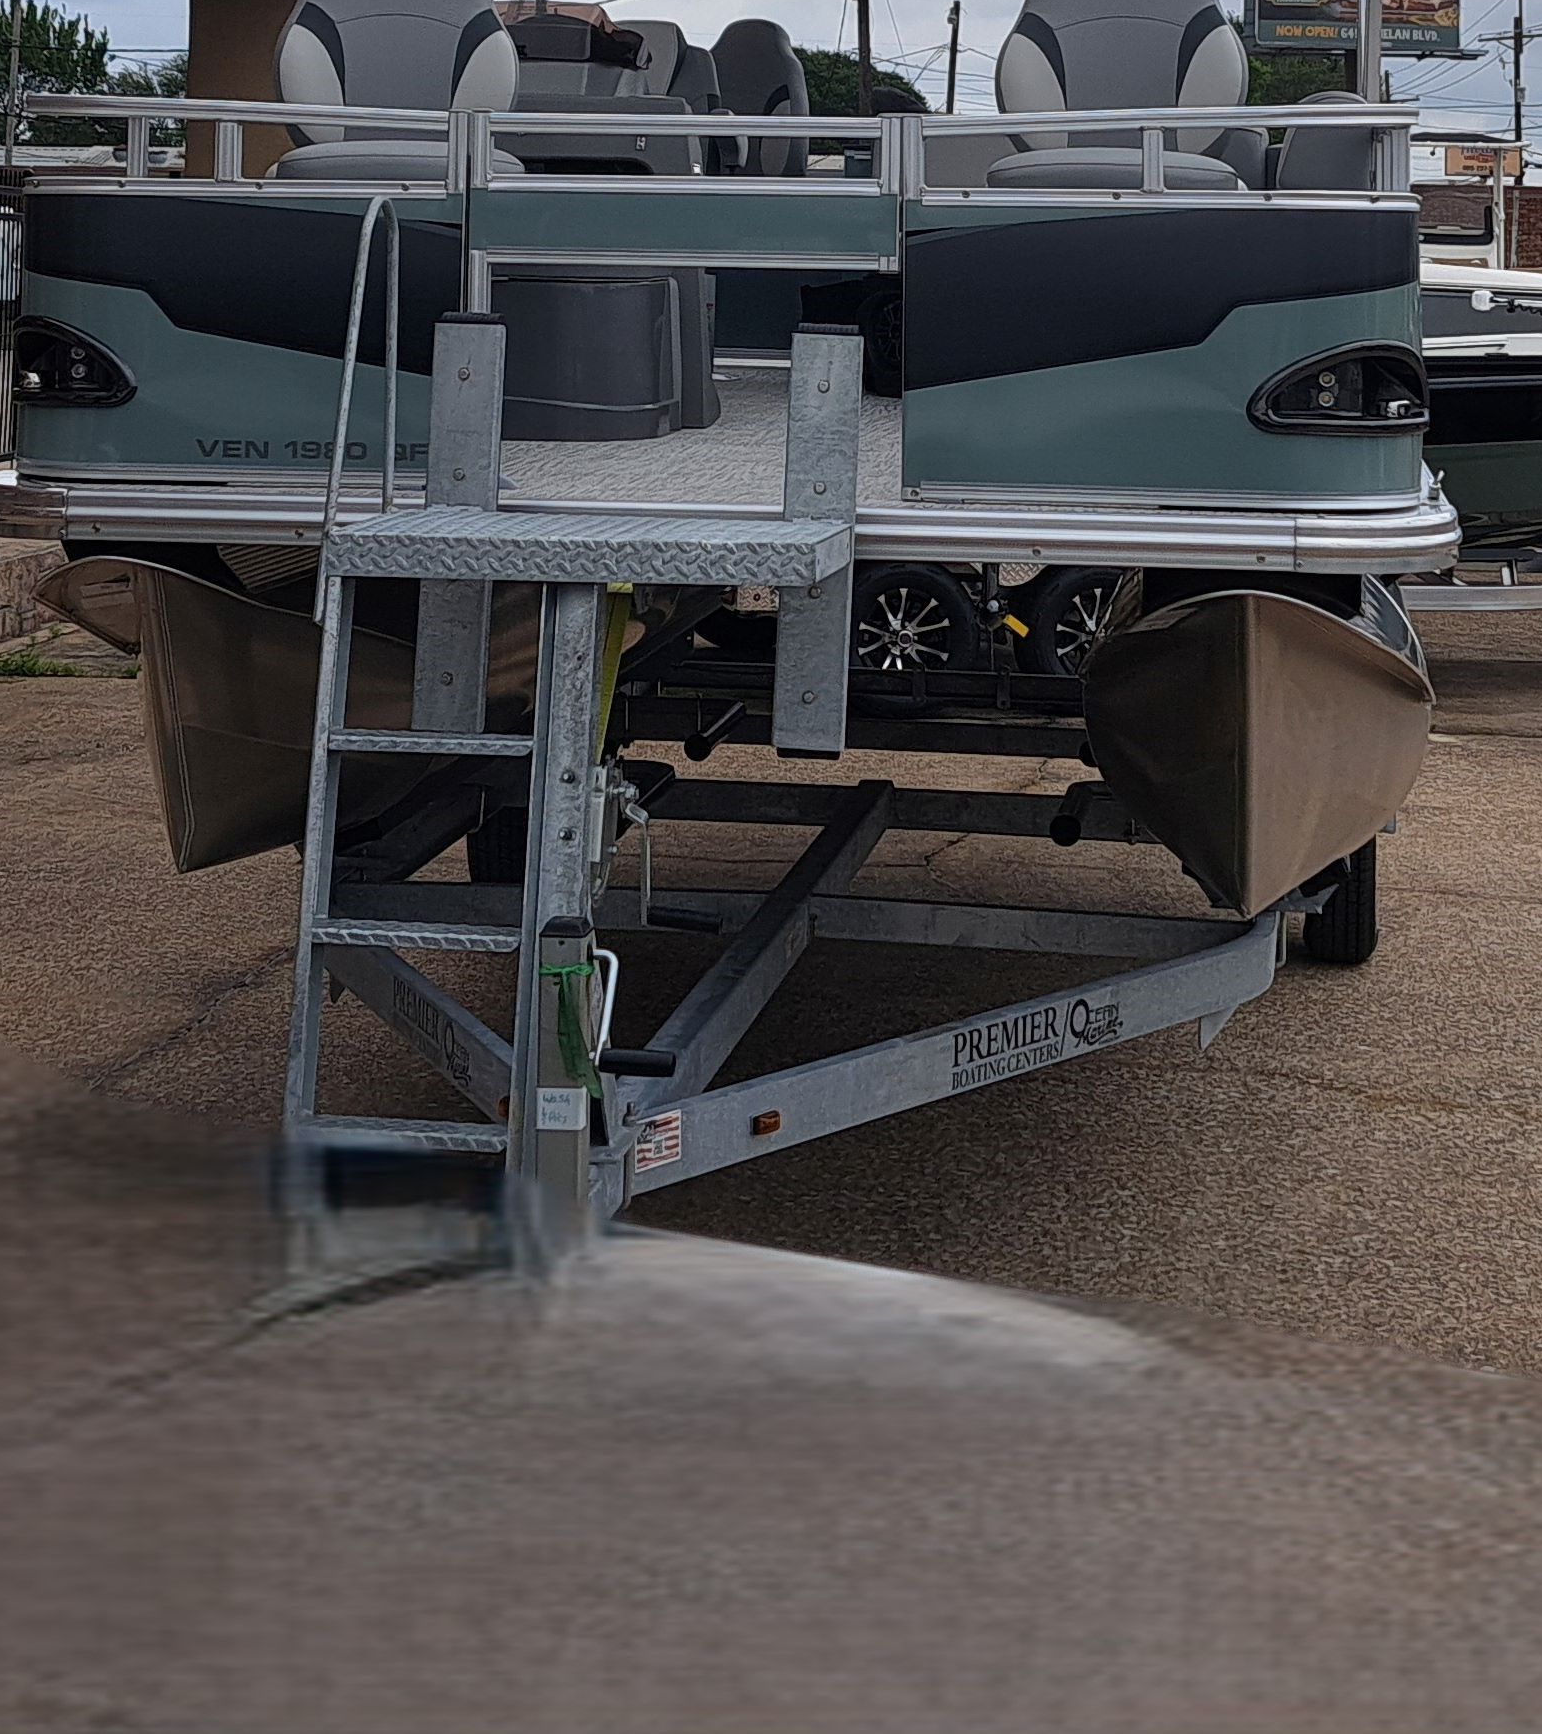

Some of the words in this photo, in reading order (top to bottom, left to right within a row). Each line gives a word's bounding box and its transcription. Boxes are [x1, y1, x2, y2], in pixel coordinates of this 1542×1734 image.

[1275, 25, 1303, 37] NOW
[1305, 26, 1338, 37] OPEN!
[1412, 30, 1441, 42] BLVD.
[195, 438, 270, 460] VEN
[951, 1006, 1060, 1069] PREMIER
[951, 1057, 1007, 1092] BOATING
[1007, 1039, 1061, 1074] CENTERS
